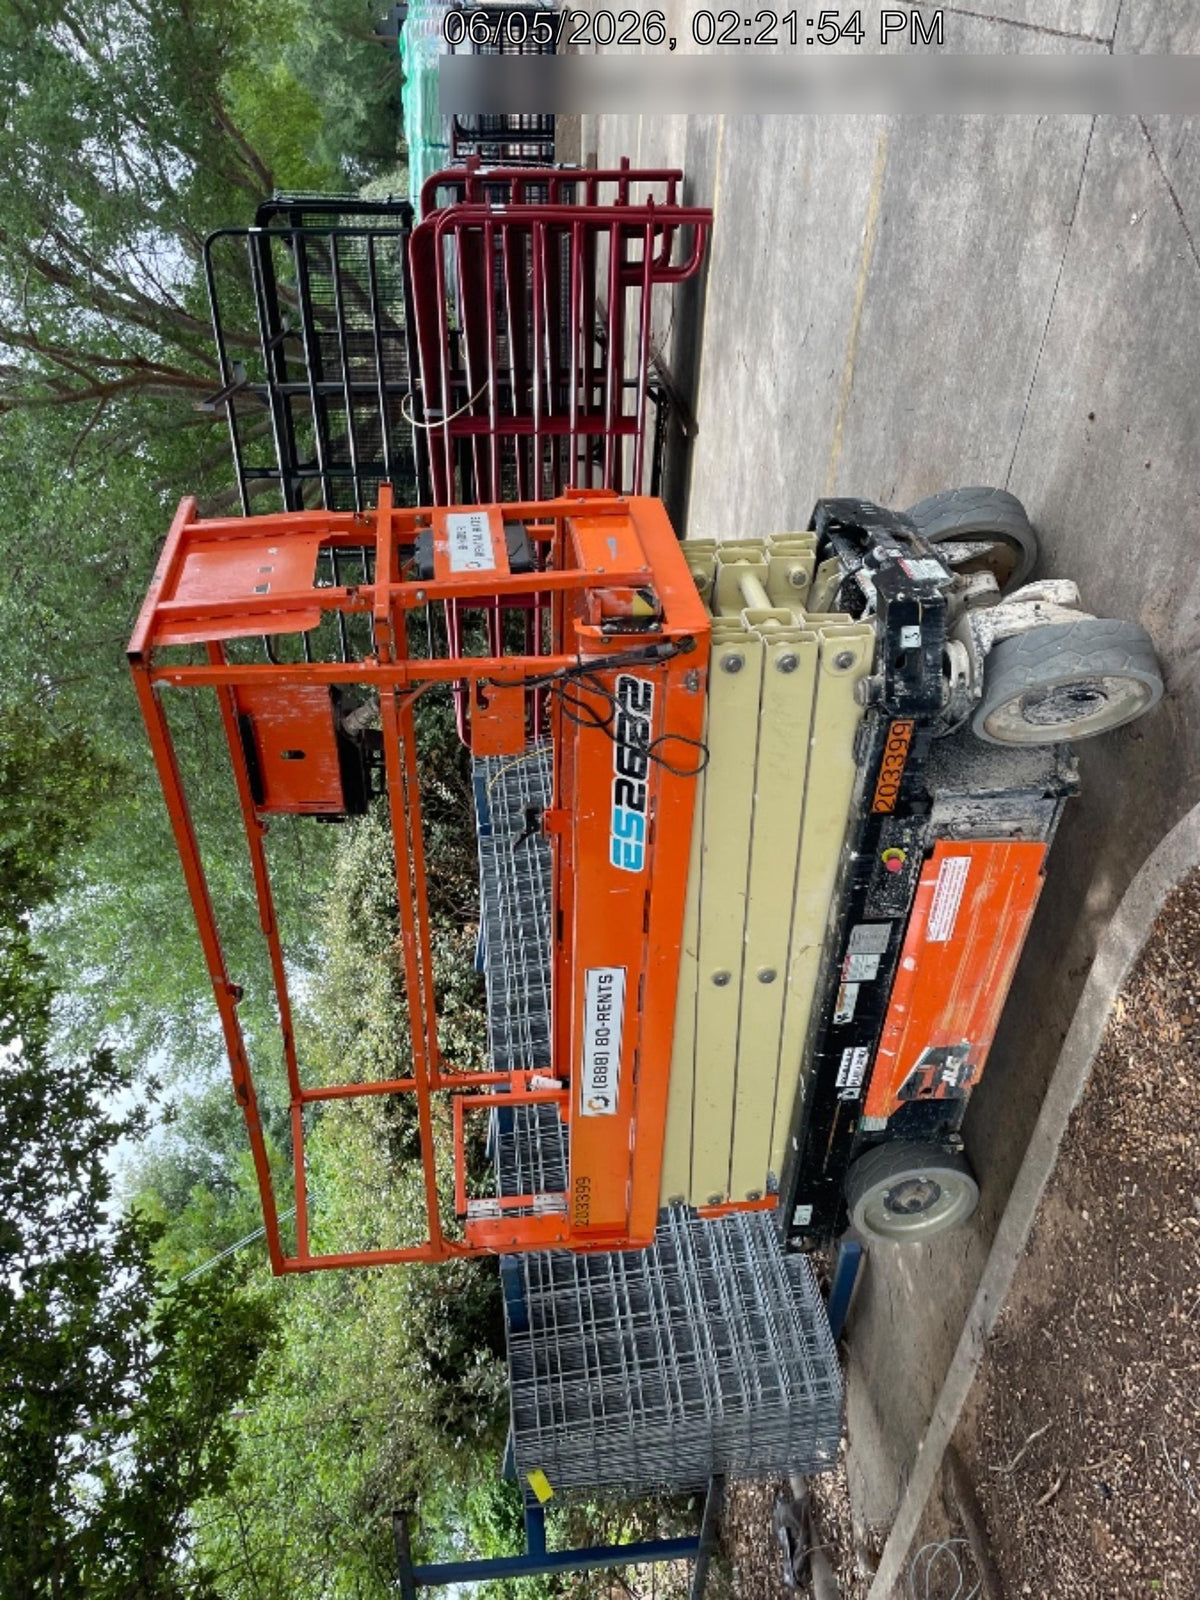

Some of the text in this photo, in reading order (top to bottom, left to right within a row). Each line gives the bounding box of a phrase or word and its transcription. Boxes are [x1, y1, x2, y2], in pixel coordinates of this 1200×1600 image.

[609, 673, 655, 872] ES2632
[874, 722, 911, 812] 203399
[591, 1051, 610, 1089] (888)
[574, 1176, 591, 1228] 203399
